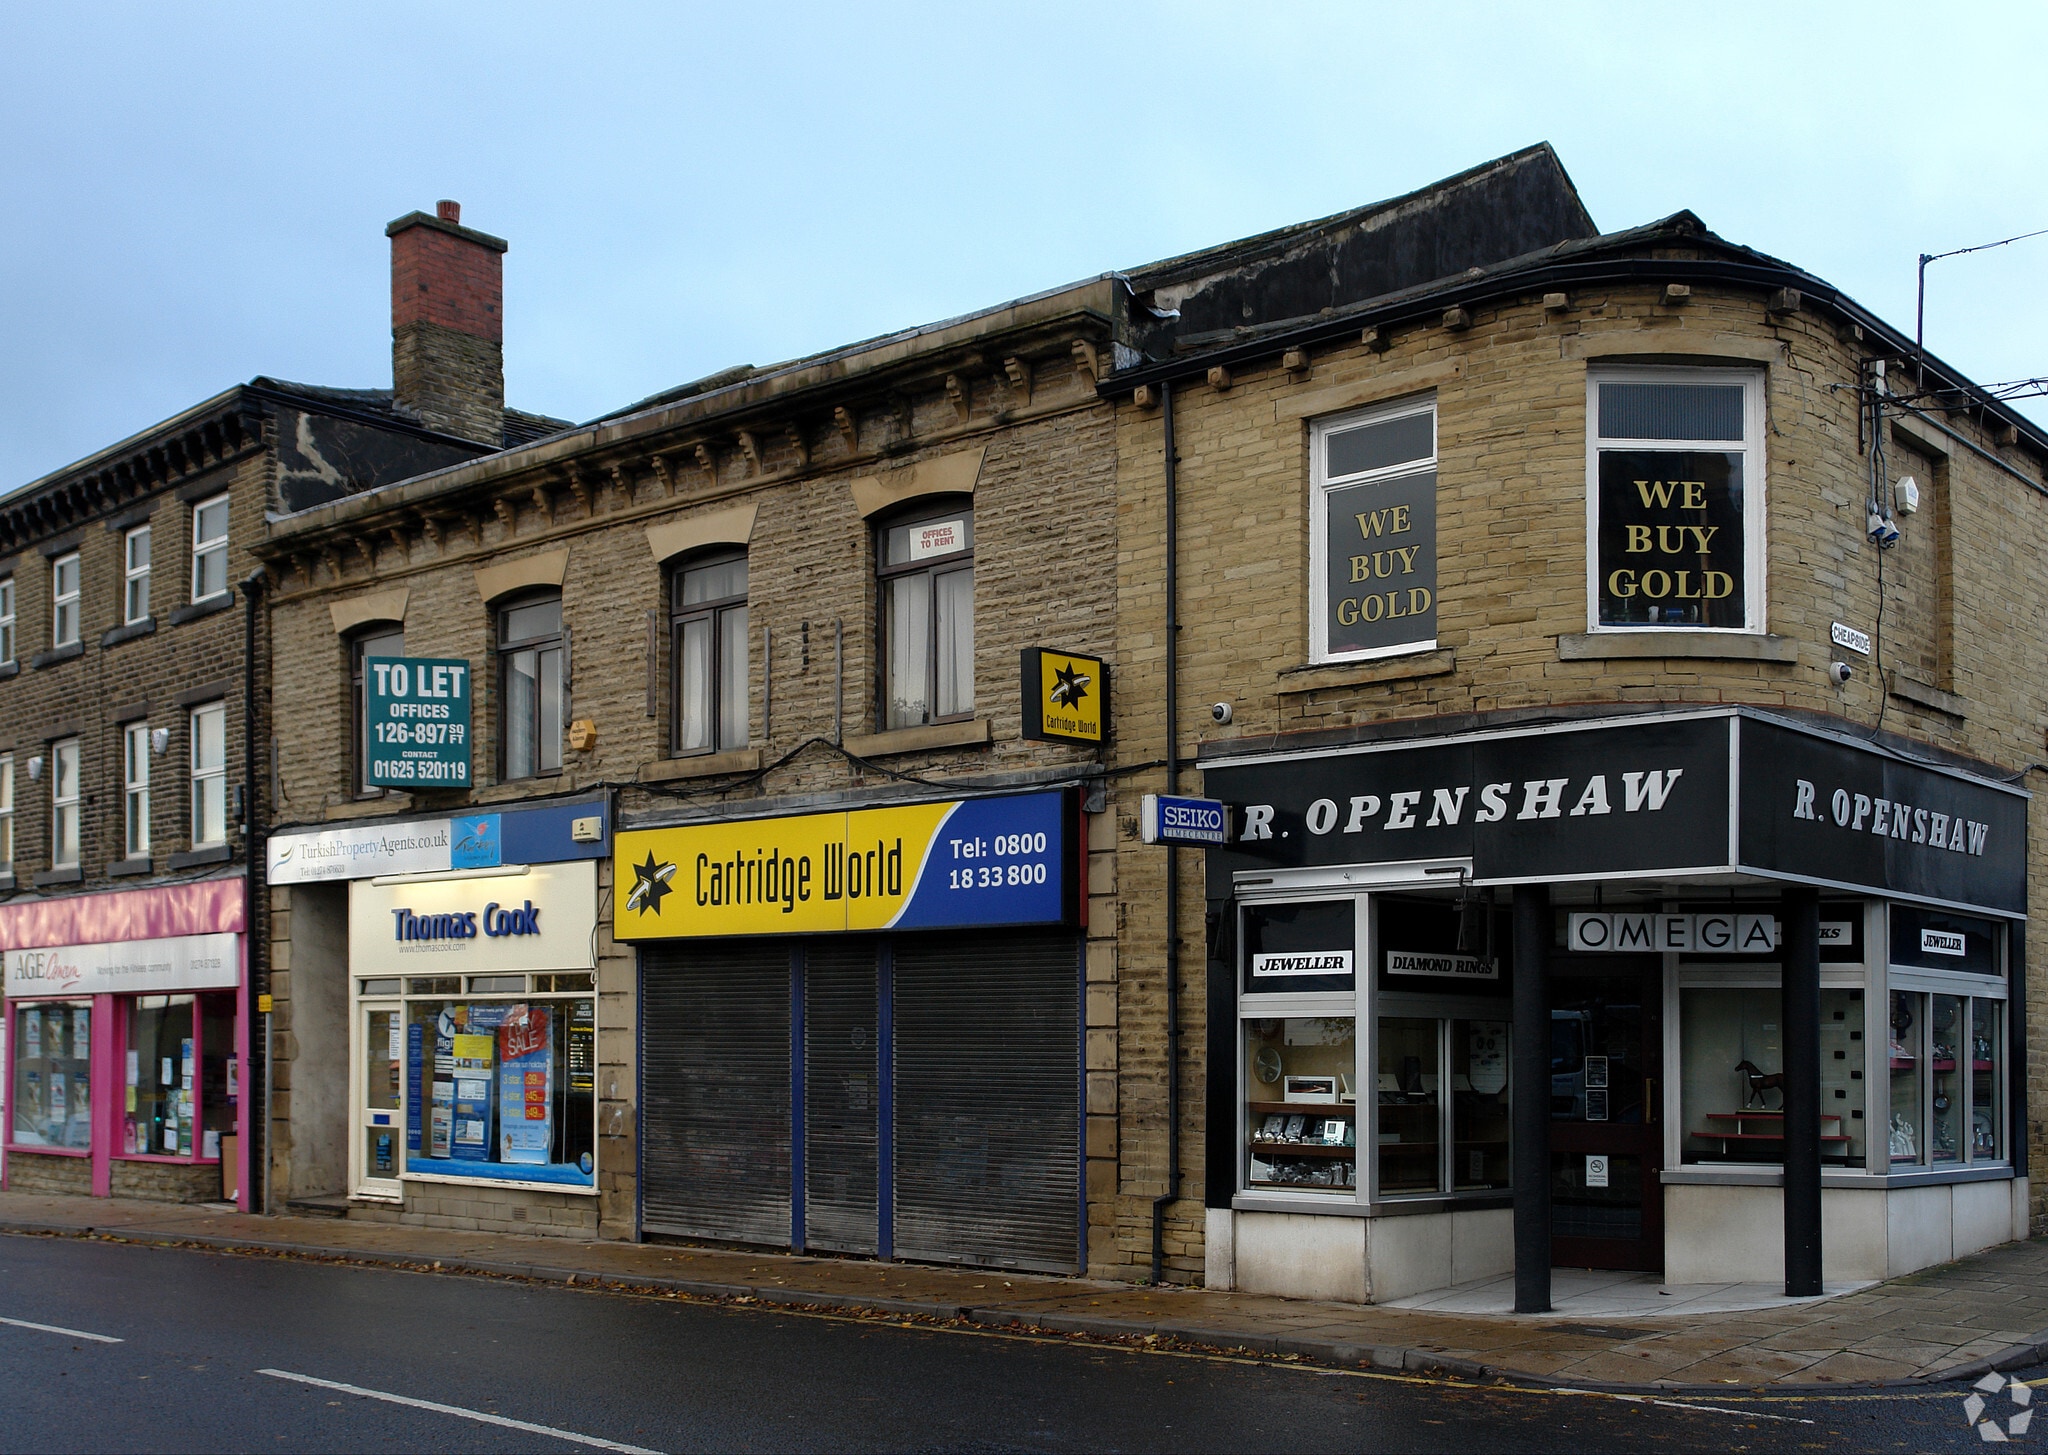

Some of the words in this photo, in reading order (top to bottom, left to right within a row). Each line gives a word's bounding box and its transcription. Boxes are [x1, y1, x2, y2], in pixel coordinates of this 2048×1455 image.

[1633, 480, 1707, 509] WE
[922, 527, 952, 539] OFFICES
[1354, 504, 1412, 540] WE
[920, 540, 931, 549] TO
[934, 536, 955, 547] RENT
[1625, 525, 1719, 554] BUY
[1349, 544, 1420, 584] BUY
[1608, 569, 1734, 599] GOLD
[1336, 586, 1432, 627] GOLD
[1833, 625, 1870, 652] CHEAPSIDE
[373, 664, 408, 697] TO
[417, 665, 465, 698] LET
[390, 703, 449, 718] OFFICES
[375, 722, 447, 744] 126-897
[448, 724, 464, 734] SQ
[1046, 714, 1076, 734] Cartridge
[1077, 719, 1097, 735] World
[449, 734, 464, 744] FT
[374, 760, 415, 779] 01625
[417, 761, 466, 780] 520119
[1164, 806, 1221, 829] SEIKO
[1240, 804, 1290, 842] R.
[1305, 768, 1684, 837] OPENSHAW
[1793, 778, 1825, 823] R.
[1831, 788, 1989, 857] OPENSHAW
[300, 830, 448, 860] TurkishPropertyAgents.co.uk
[949, 838, 987, 860] Tel:
[993, 832, 1047, 856] 0800
[1165, 828, 1221, 841] TIMECENTRE
[696, 847, 811, 914] Cartridge
[824, 837, 903, 901] World
[949, 868, 974, 890] 18
[978, 866, 1003, 888] 33
[1007, 863, 1047, 886] 800
[391, 908, 477, 941] Thomas
[483, 900, 541, 937] Cook
[1578, 917, 1772, 948] OMEGA
[399, 942, 467, 954] www.thomascook.com
[1923, 934, 1962, 951] JEWELLER
[14, 953, 45, 980] AGE
[1259, 956, 1344, 972] JEWELLER
[1392, 956, 1452, 973] DIAMOND
[1455, 958, 1494, 974] RINGS
[508, 1030, 539, 1056] SALE
